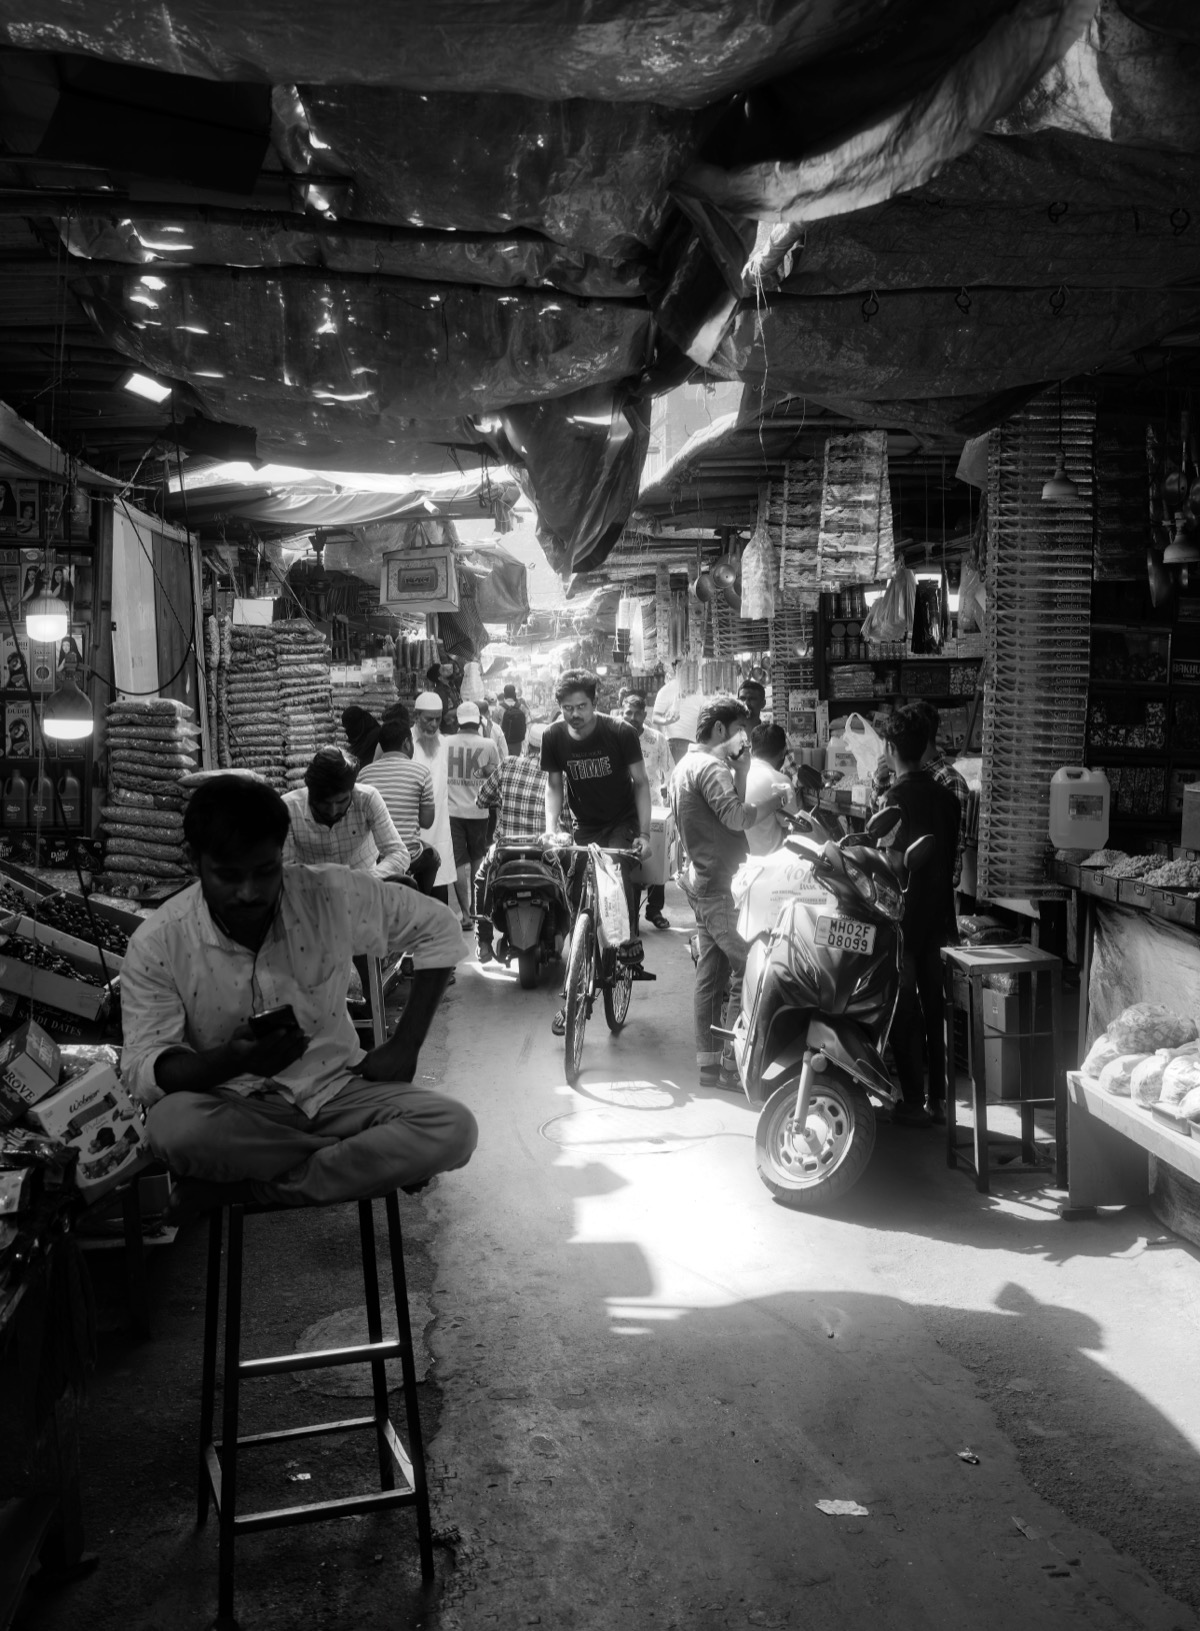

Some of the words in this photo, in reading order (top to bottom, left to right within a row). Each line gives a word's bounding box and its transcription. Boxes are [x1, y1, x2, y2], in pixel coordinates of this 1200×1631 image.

[1056, 614, 1082, 622] Comfort
[1056, 626, 1081, 634] Comfort
[1056, 639, 1082, 647] Comfort
[1056, 664, 1081, 672] Comfort
[448, 746, 484, 779] HK
[567, 755, 612, 780] TIME
[830, 919, 870, 938] MH02F
[51, 1020, 82, 1037] DATES
[4, 1071, 36, 1102] ROVE
